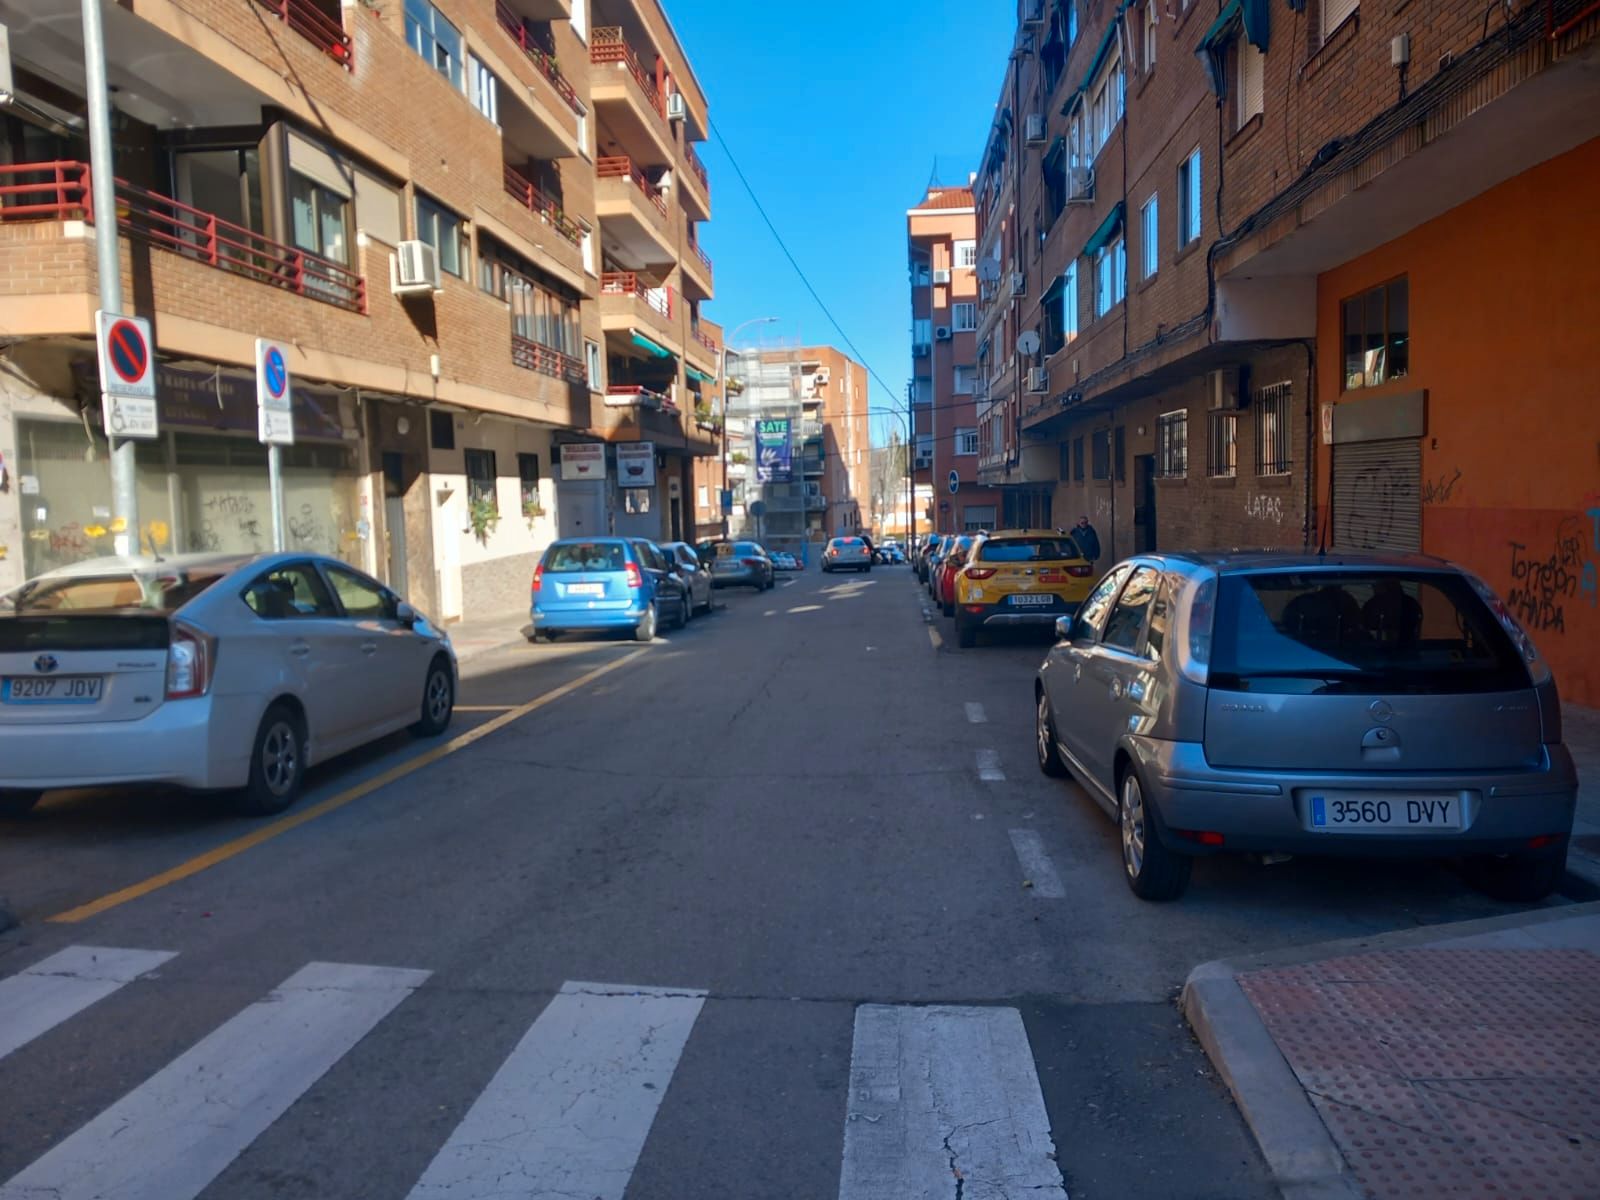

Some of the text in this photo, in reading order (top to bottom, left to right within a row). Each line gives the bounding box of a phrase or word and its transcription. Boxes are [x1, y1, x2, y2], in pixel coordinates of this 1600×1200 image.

[759, 420, 788, 433] SATE
[12, 679, 98, 697] 9207 JDV
[1331, 800, 1450, 823] 3560 DVY
